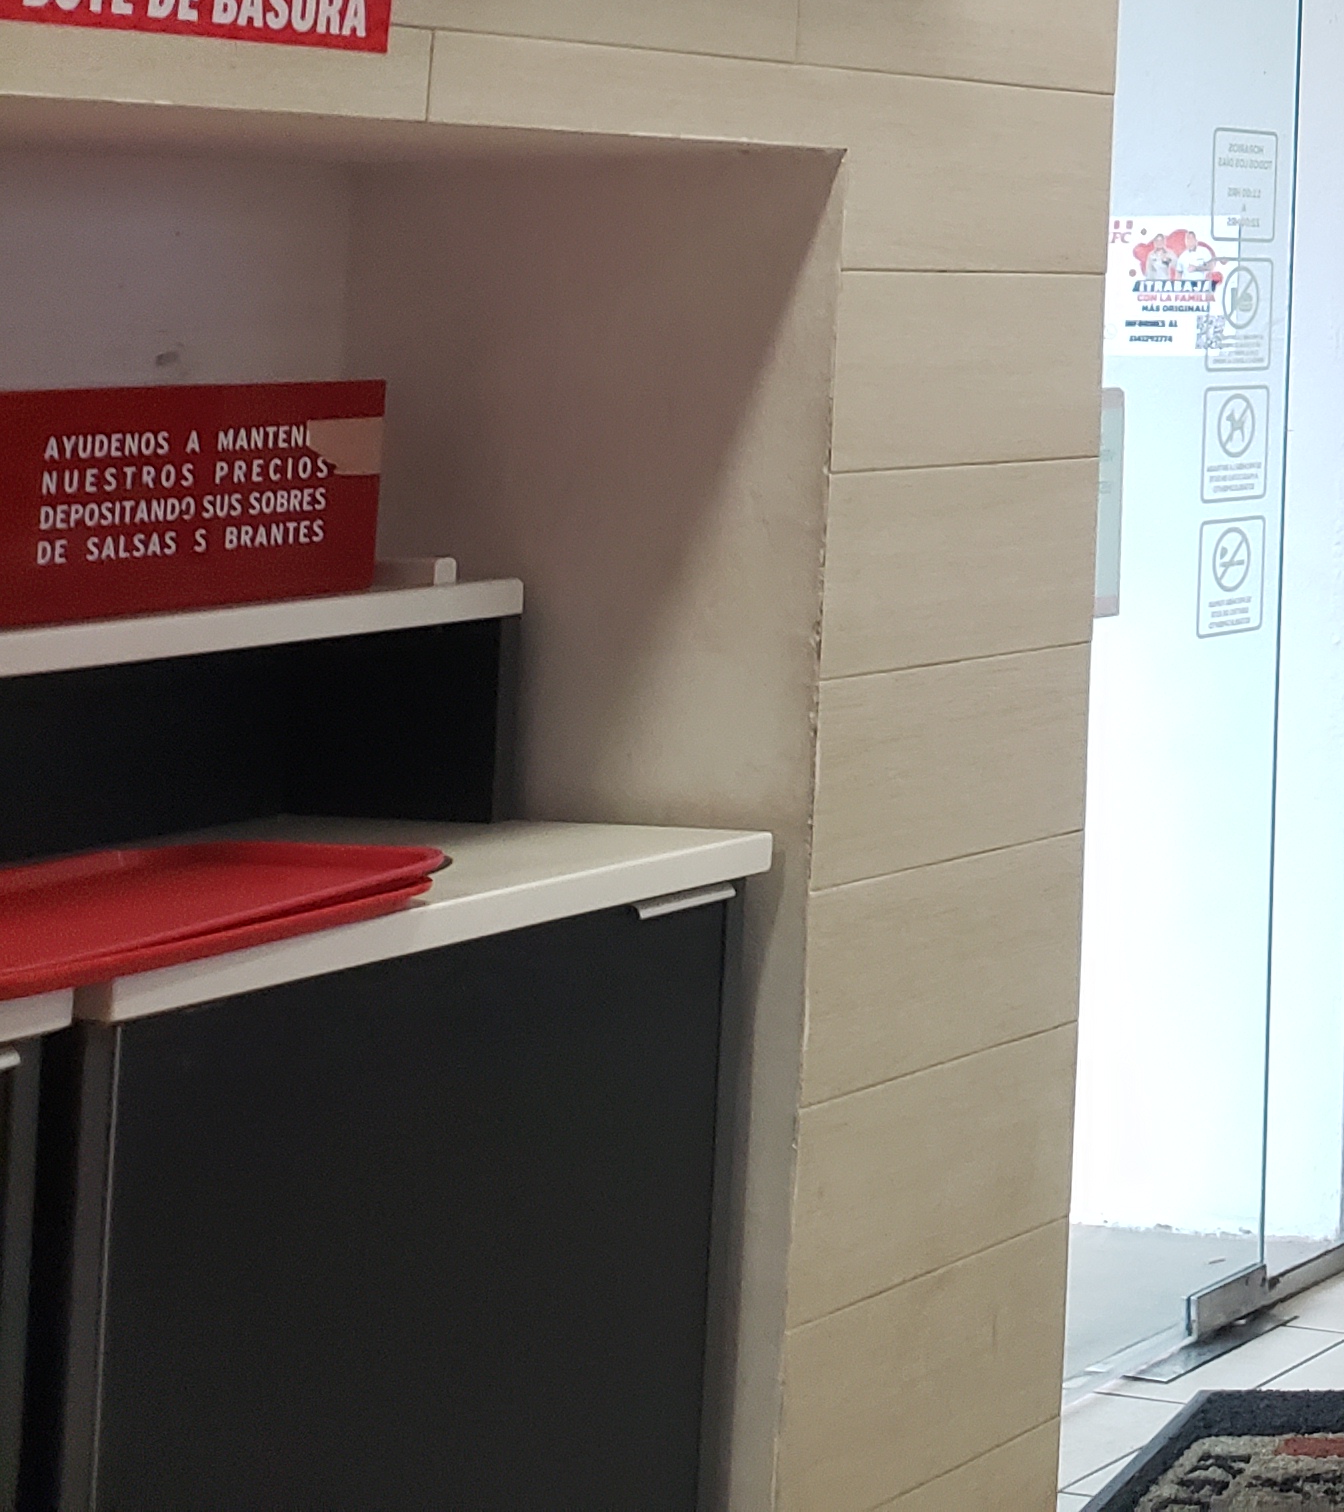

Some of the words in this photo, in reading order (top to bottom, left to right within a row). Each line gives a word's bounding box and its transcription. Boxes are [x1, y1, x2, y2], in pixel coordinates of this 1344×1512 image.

[1137, 293, 1158, 303] CON
[1159, 293, 1173, 303] LA
[1174, 293, 1216, 303] FAMILIA
[1142, 304, 1161, 312] MÁS
[44, 430, 170, 462] AYUDENOS
[185, 429, 200, 455] A
[41, 463, 195, 496] NUESTROS
[214, 456, 330, 485] PRECIOS
[38, 495, 197, 531] DEPOSITANDO
[201, 492, 243, 520] SUS
[248, 487, 327, 516] SOBRES
[36, 539, 68, 567] DE
[86, 530, 178, 563] SALSAS
